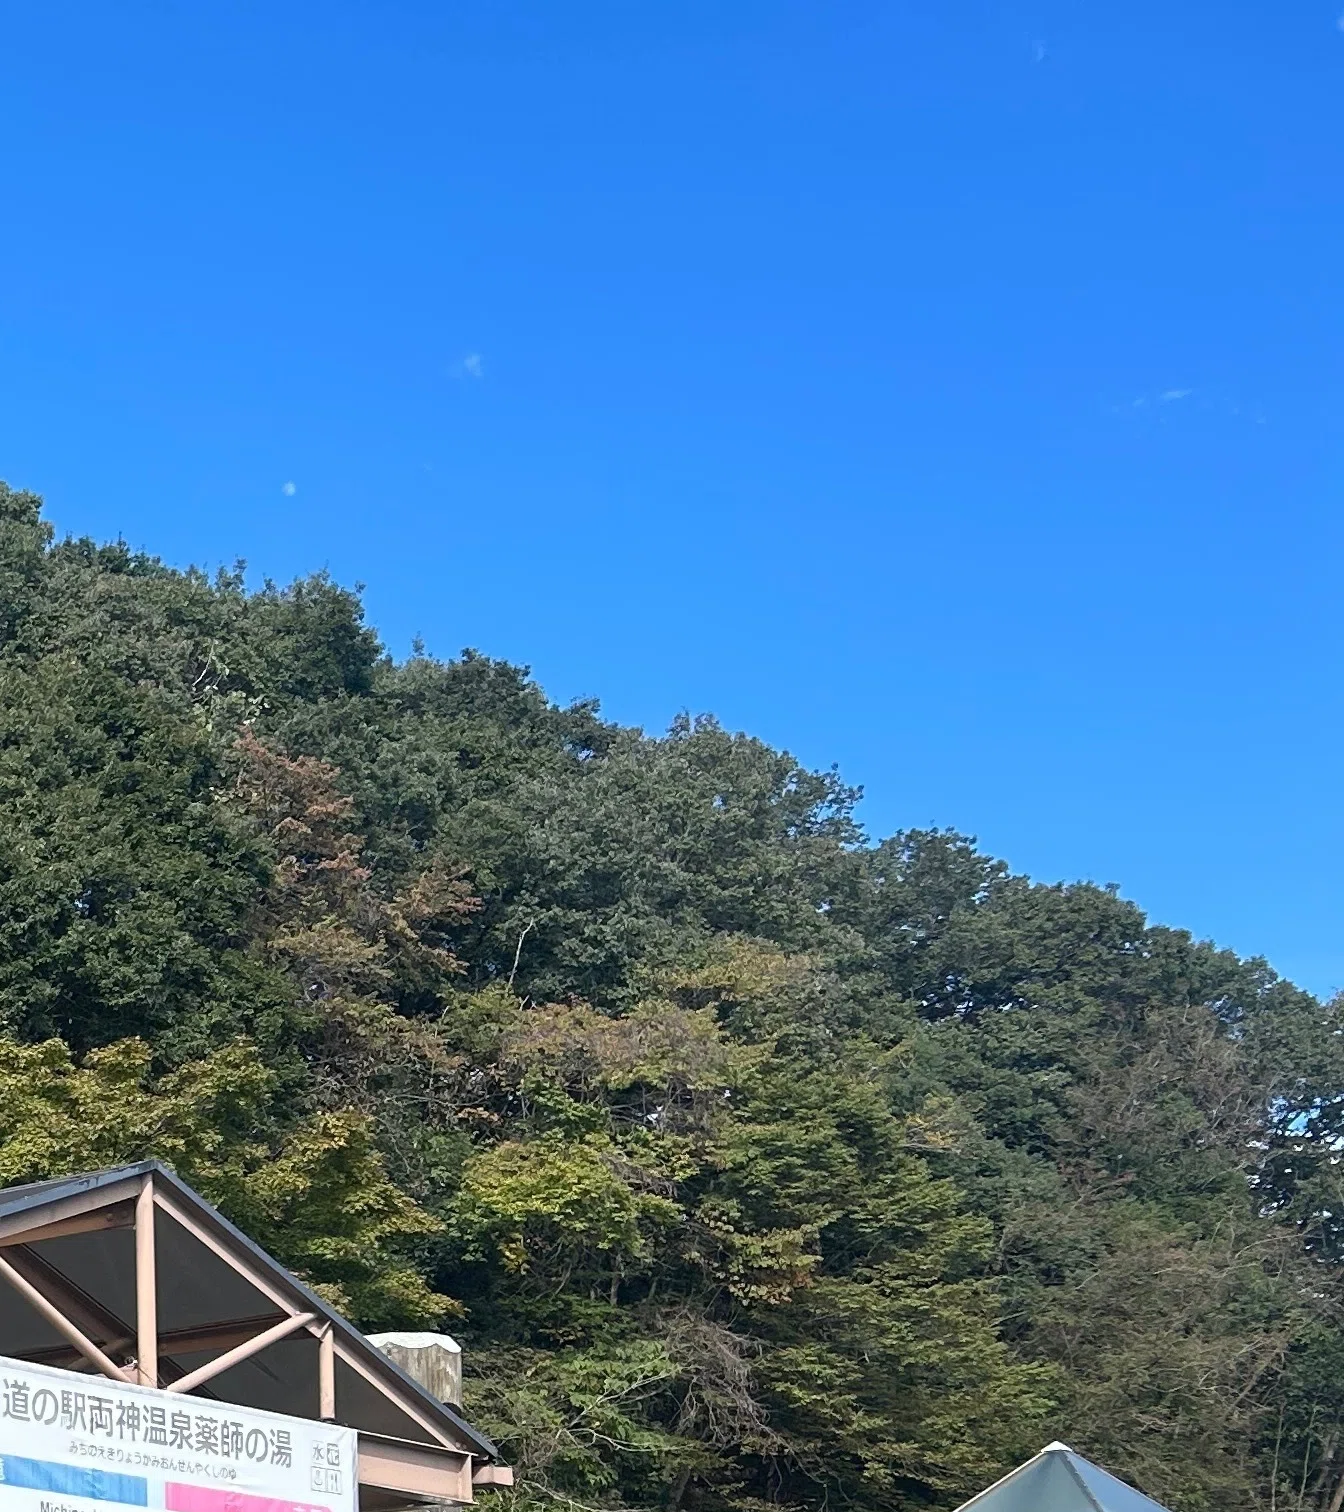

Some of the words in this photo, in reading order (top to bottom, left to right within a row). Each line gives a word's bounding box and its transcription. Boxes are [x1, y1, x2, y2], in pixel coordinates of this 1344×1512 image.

[2, 1378, 293, 1469] 道の駅両神温泉薬師の湯
[312, 1443, 325, 1461] 水
